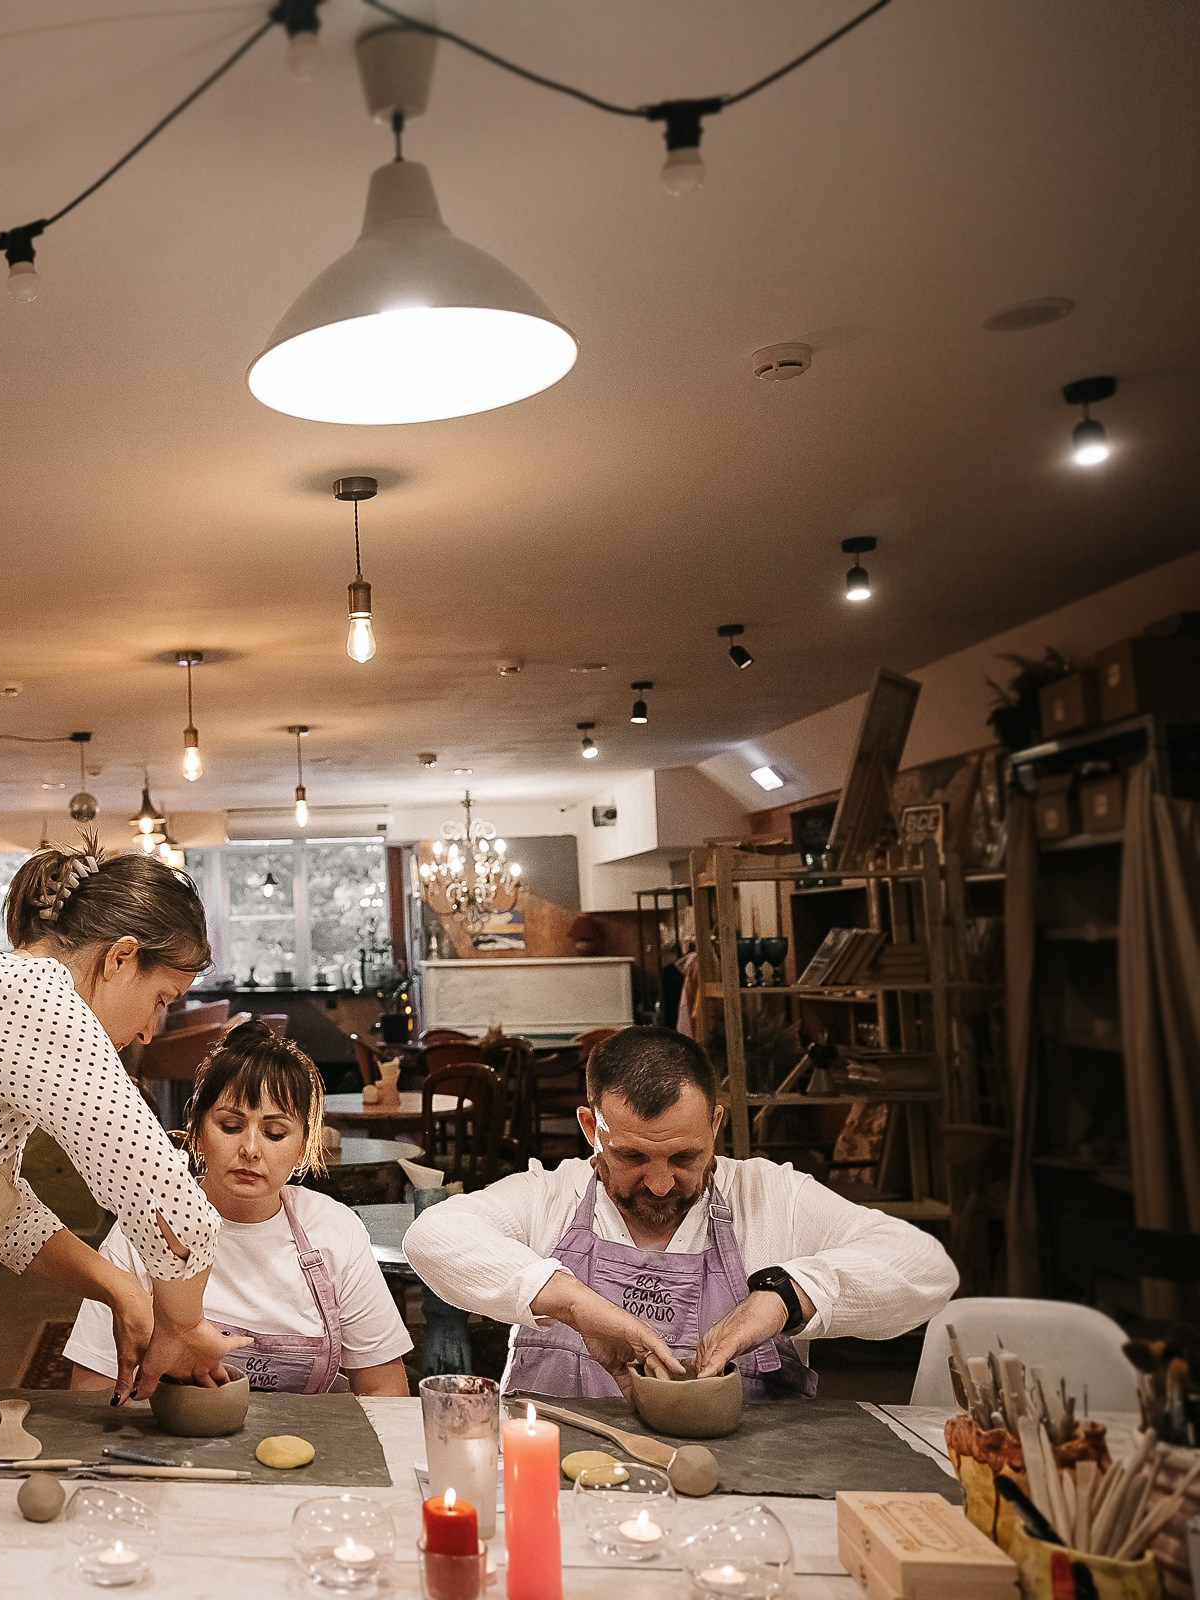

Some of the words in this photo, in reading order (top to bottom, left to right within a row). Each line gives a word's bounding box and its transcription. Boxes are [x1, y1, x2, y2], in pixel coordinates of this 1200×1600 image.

[635, 1275, 662, 1290] ВСЕ
[622, 1300, 675, 1322] ХОРОШО
[246, 1357, 271, 1372] ВСЕ
